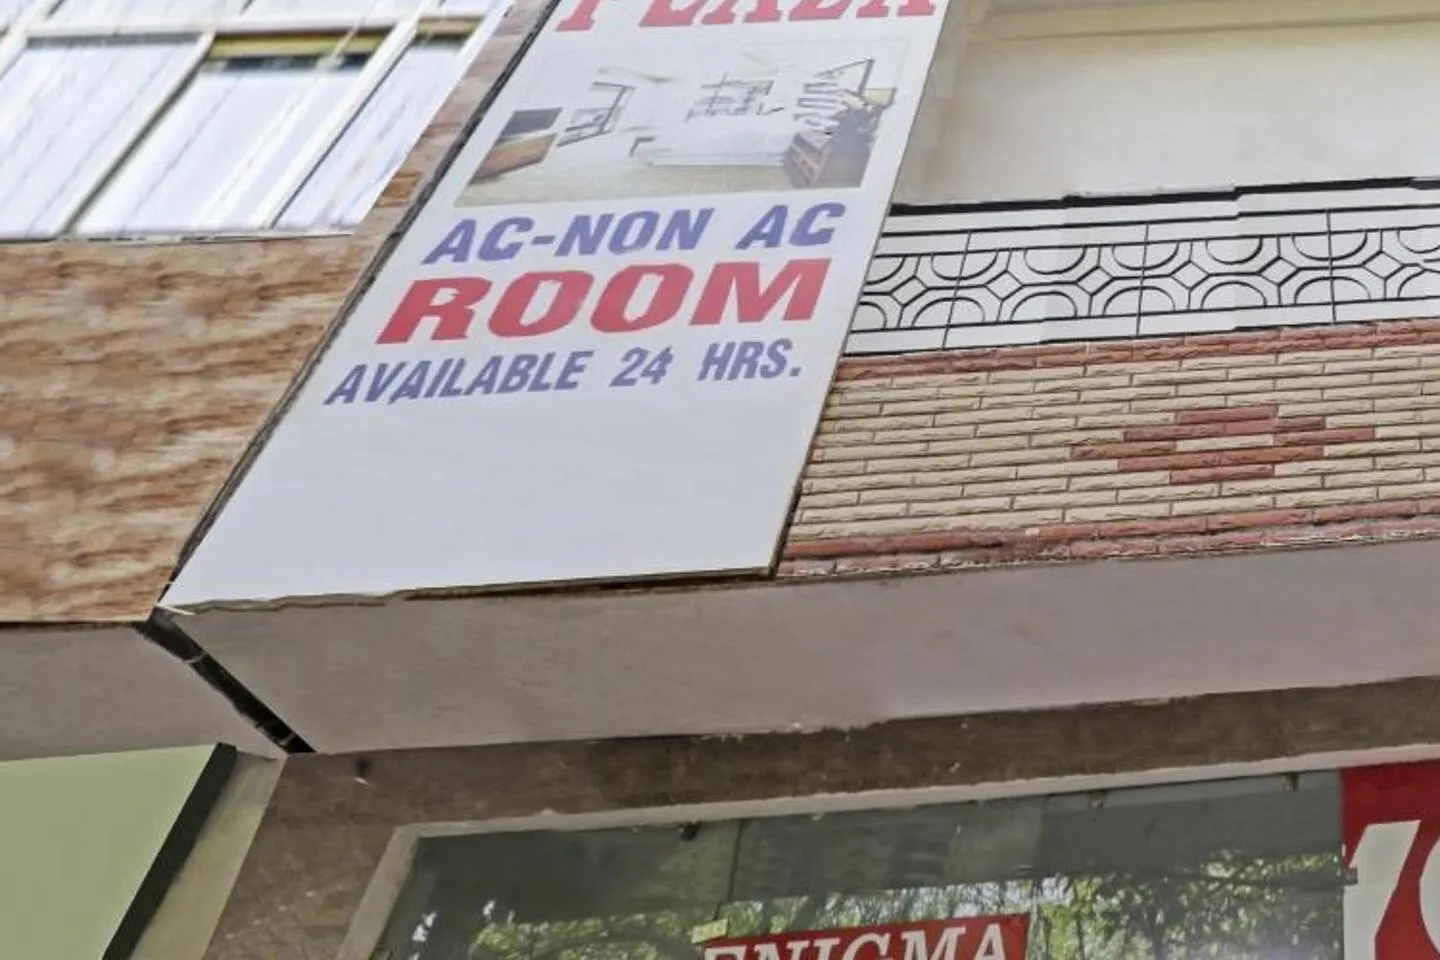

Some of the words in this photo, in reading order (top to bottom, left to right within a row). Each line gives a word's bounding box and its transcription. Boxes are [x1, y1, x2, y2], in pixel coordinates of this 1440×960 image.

[421, 207, 713, 266] AC-NON
[735, 202, 846, 250] AC
[375, 257, 832, 345] ROOM
[323, 350, 594, 406] AVAILABLE
[609, 347, 674, 387] 24
[699, 339, 803, 381] HRS.
